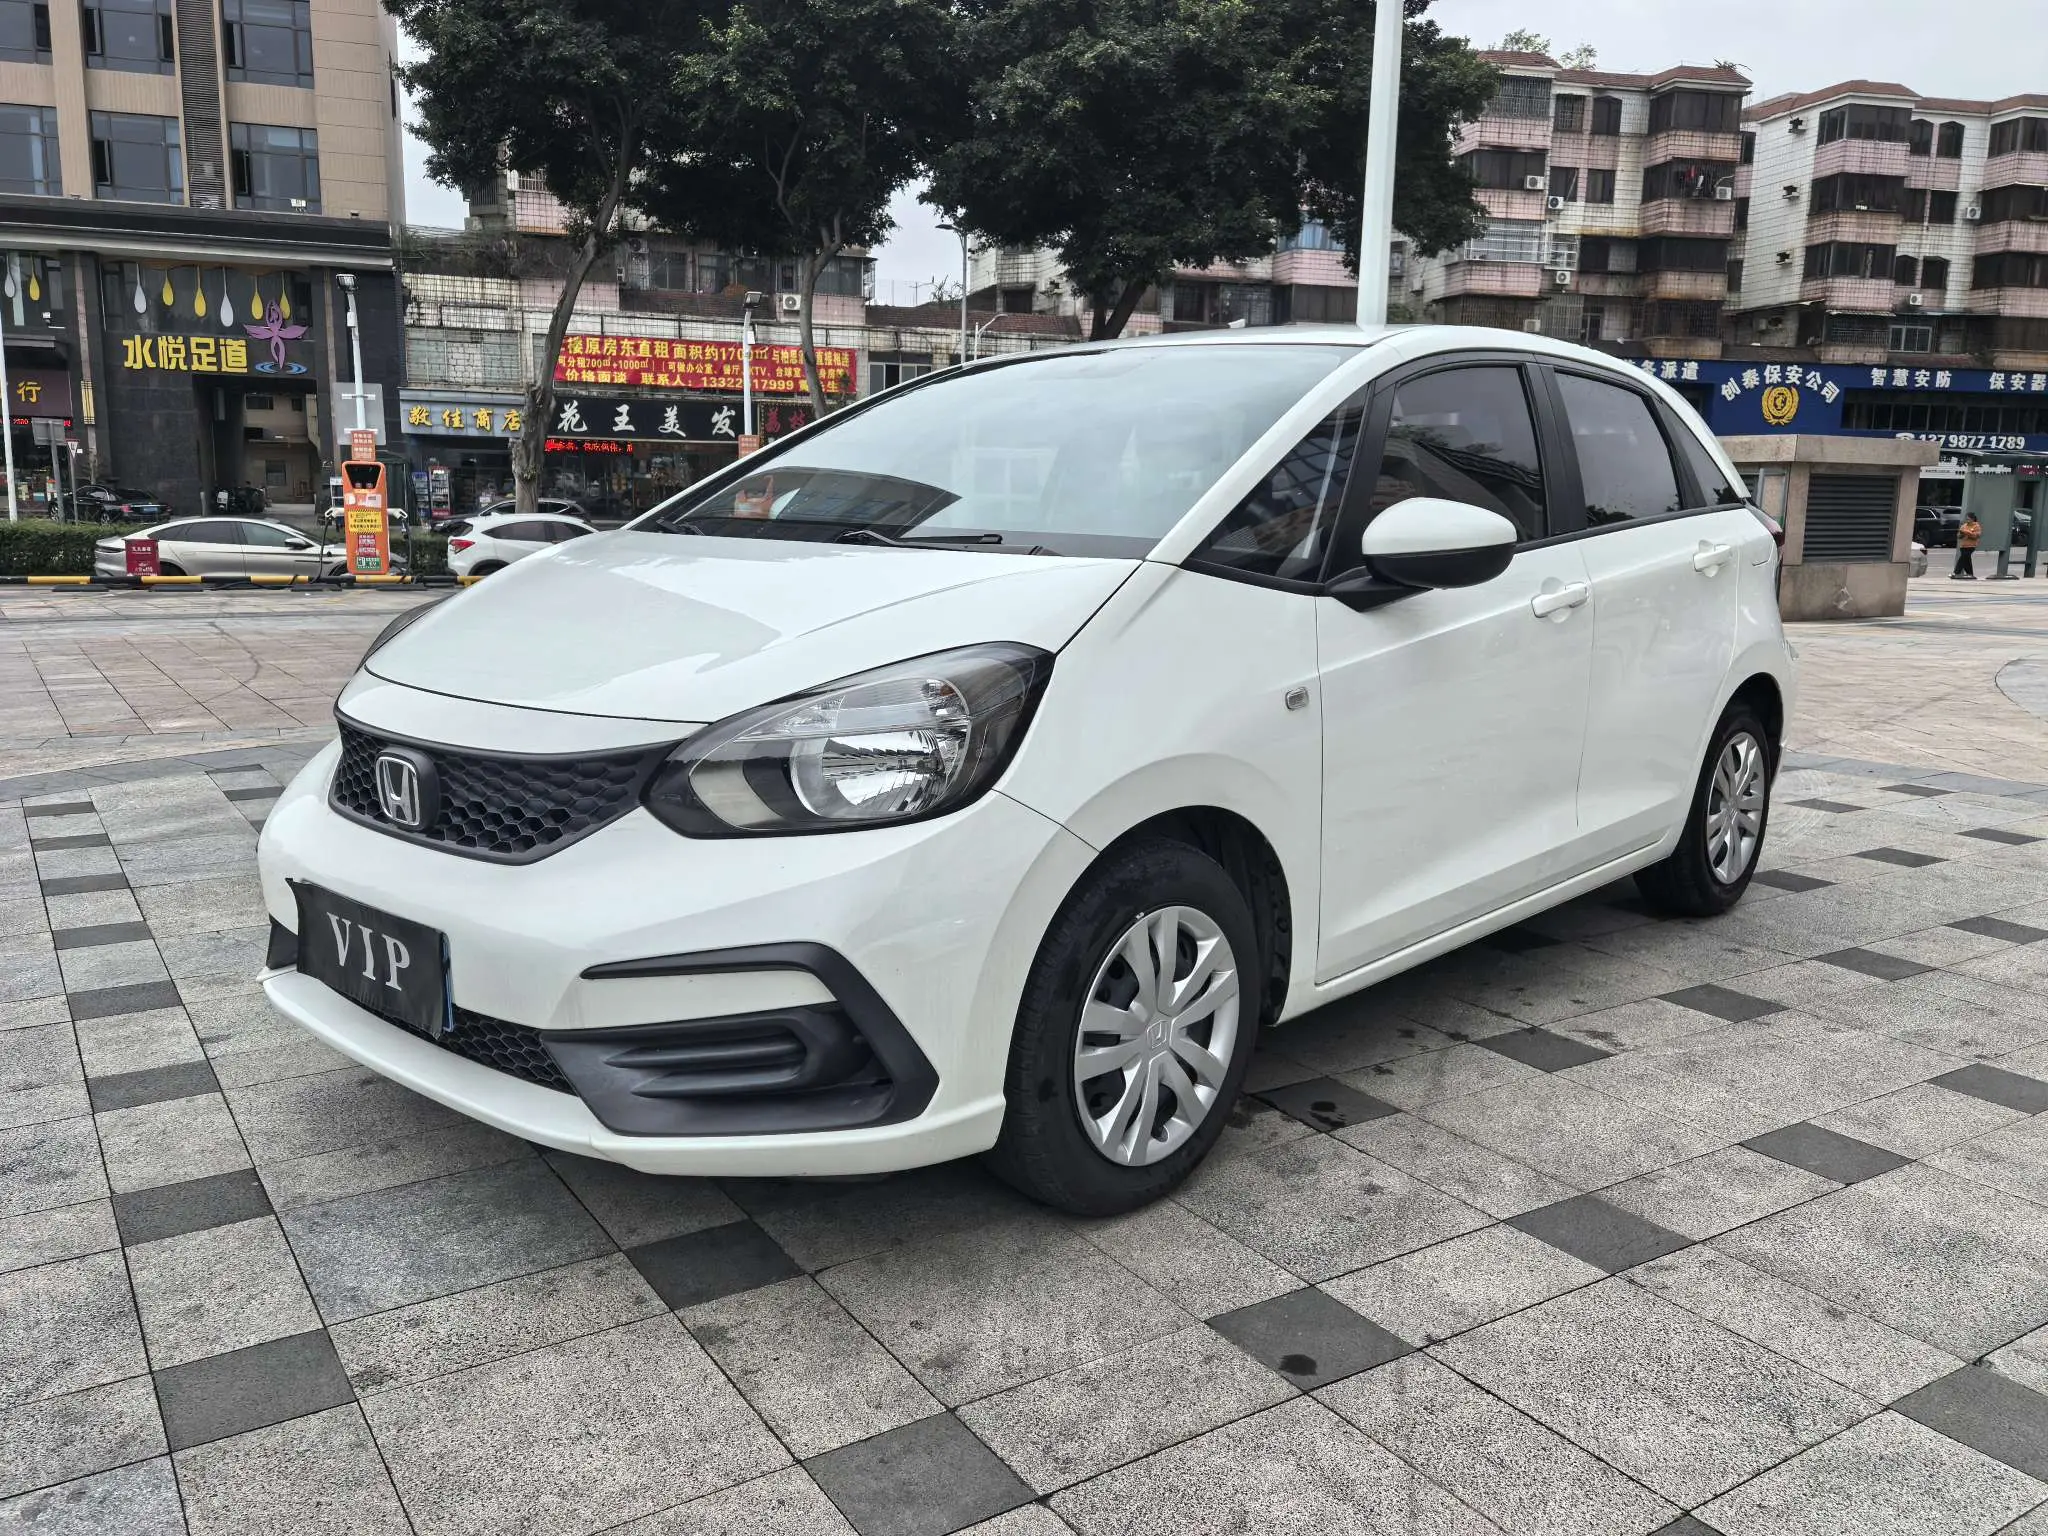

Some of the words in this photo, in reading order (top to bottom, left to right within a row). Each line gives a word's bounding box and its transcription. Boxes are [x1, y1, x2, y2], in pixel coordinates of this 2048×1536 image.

[122, 334, 248, 374] 水悦足道
[1624, 359, 1699, 380] 务派遣
[16, 381, 42, 403] 行
[565, 368, 627, 384] 价格面谈
[701, 376, 794, 391] 1332217999
[1720, 364, 1841, 404] 创泰保安公司
[1870, 367, 1953, 389] 智慧安防
[557, 399, 736, 438] 花王美发
[326, 911, 411, 992] VIP
